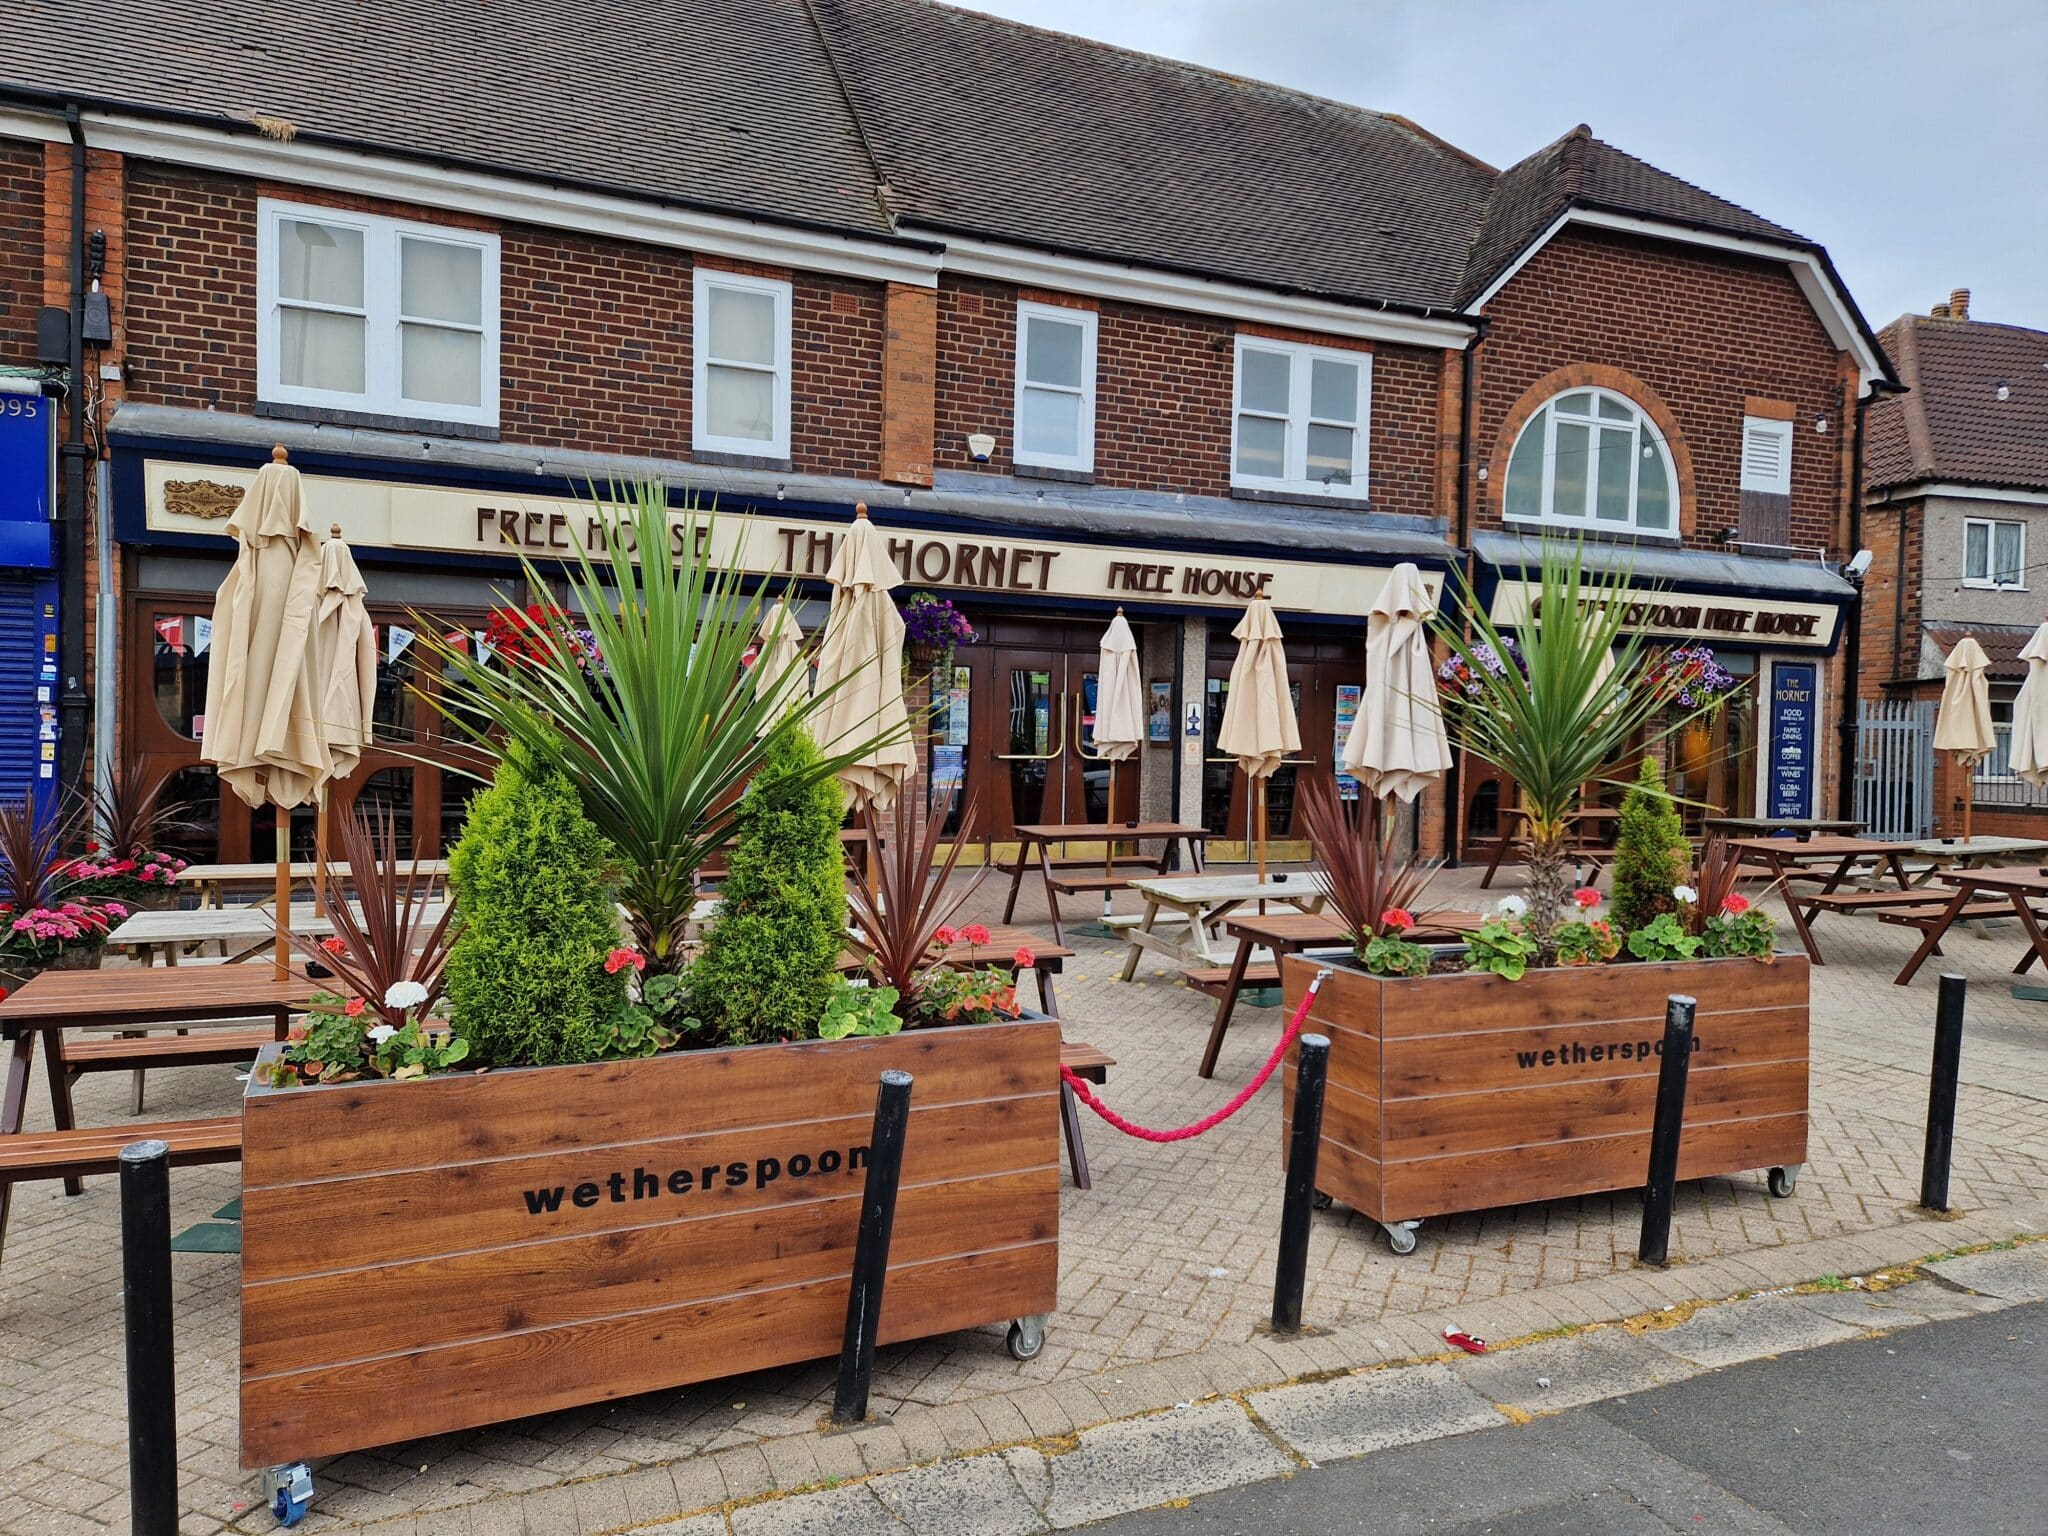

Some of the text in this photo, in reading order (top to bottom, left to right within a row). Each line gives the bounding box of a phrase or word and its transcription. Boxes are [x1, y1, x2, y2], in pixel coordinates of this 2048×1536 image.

[477, 507, 712, 560] FREE HOSE
[778, 528, 1061, 590] TH HORNET
[1107, 561, 1274, 600] FREE HOUSE
[1786, 679, 1799, 688] THE
[1776, 689, 1810, 702] HORNET
[1783, 708, 1802, 716] FOOD
[1783, 726, 1801, 734] FAMILY
[1781, 770, 1800, 778] WINES
[1779, 783, 1801, 791] GLOBAL
[1779, 807, 1799, 815] SPIRITS
[1517, 1036, 1700, 1069] wetherspon
[523, 1146, 871, 1215] wetherspoon
